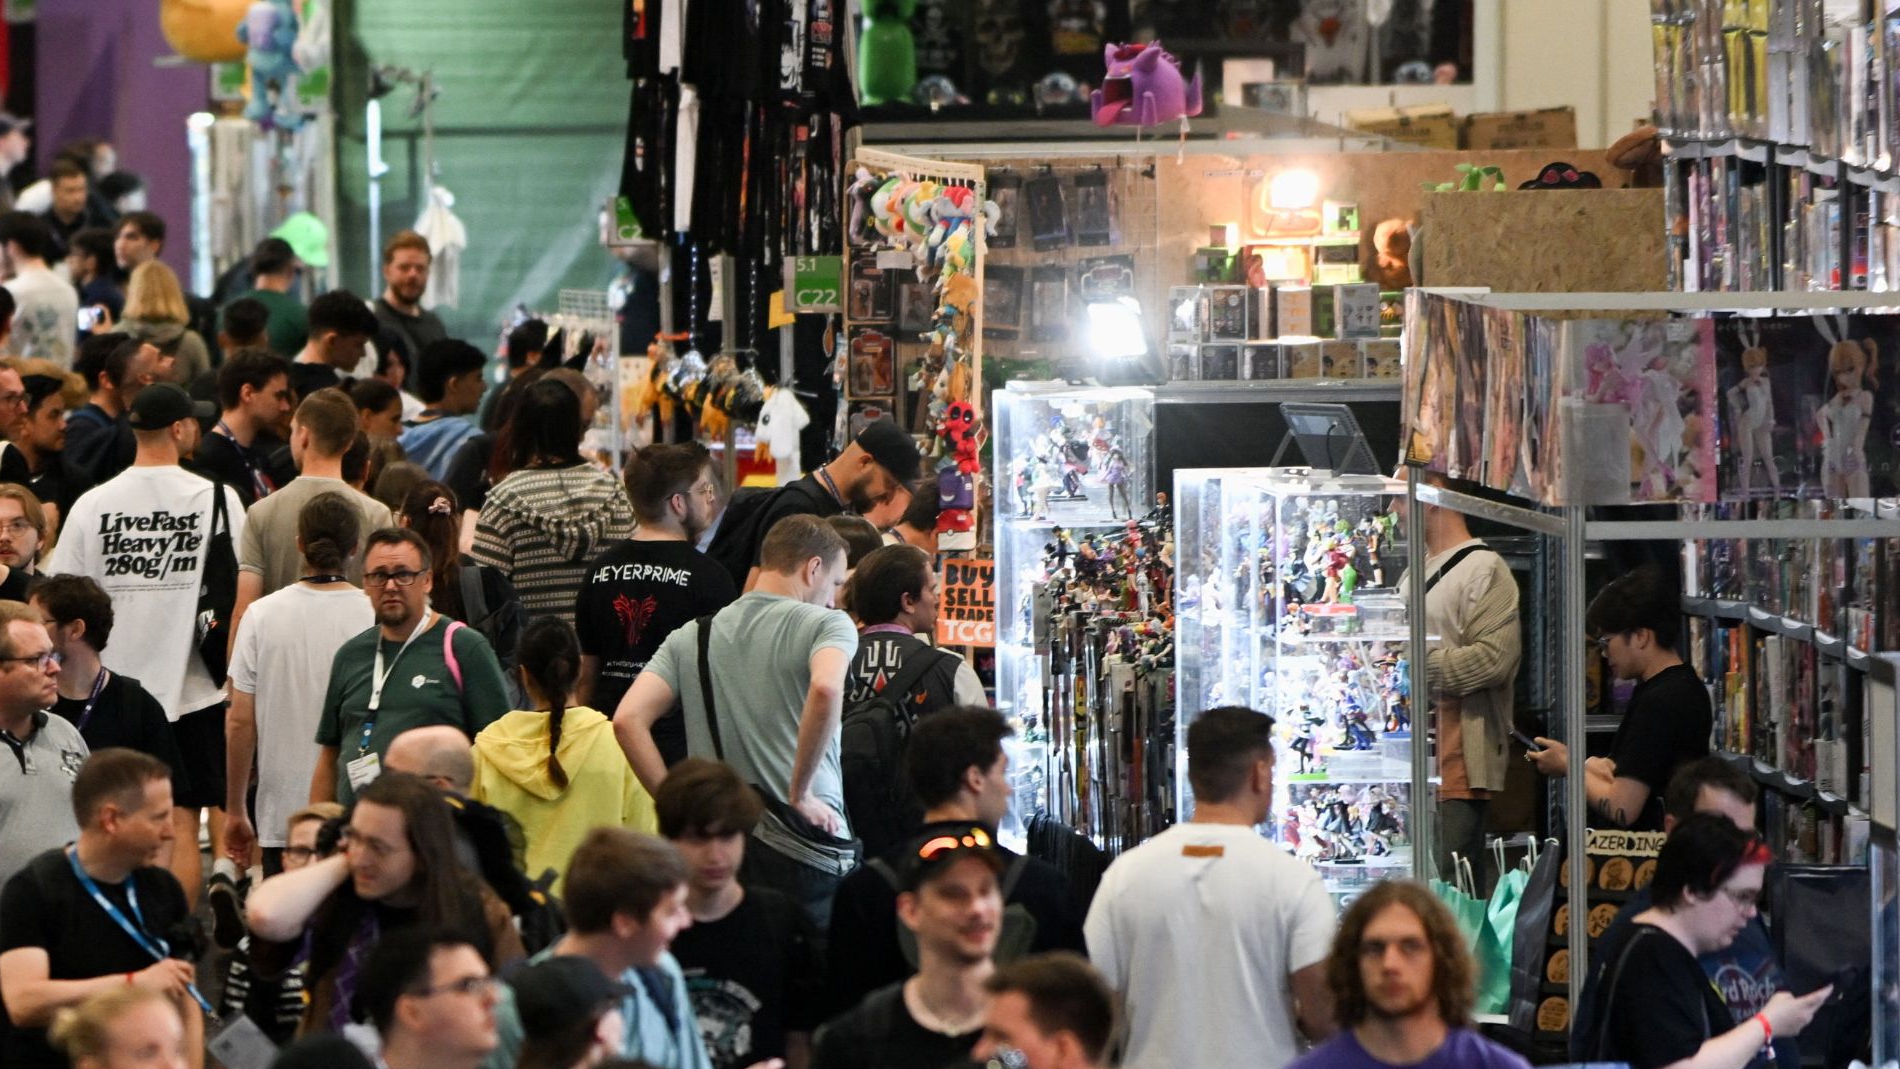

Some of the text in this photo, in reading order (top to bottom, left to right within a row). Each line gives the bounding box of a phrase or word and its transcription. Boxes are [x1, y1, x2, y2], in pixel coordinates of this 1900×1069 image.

[797, 258, 816, 272] 5.1
[796, 289, 837, 308] C22
[592, 563, 692, 587] HEYERPRIME
[945, 564, 995, 588] BUY
[944, 587, 994, 607] SELL
[944, 607, 994, 622] TRADE
[943, 621, 993, 643] TCG
[1584, 835, 1665, 851] AZERDING
